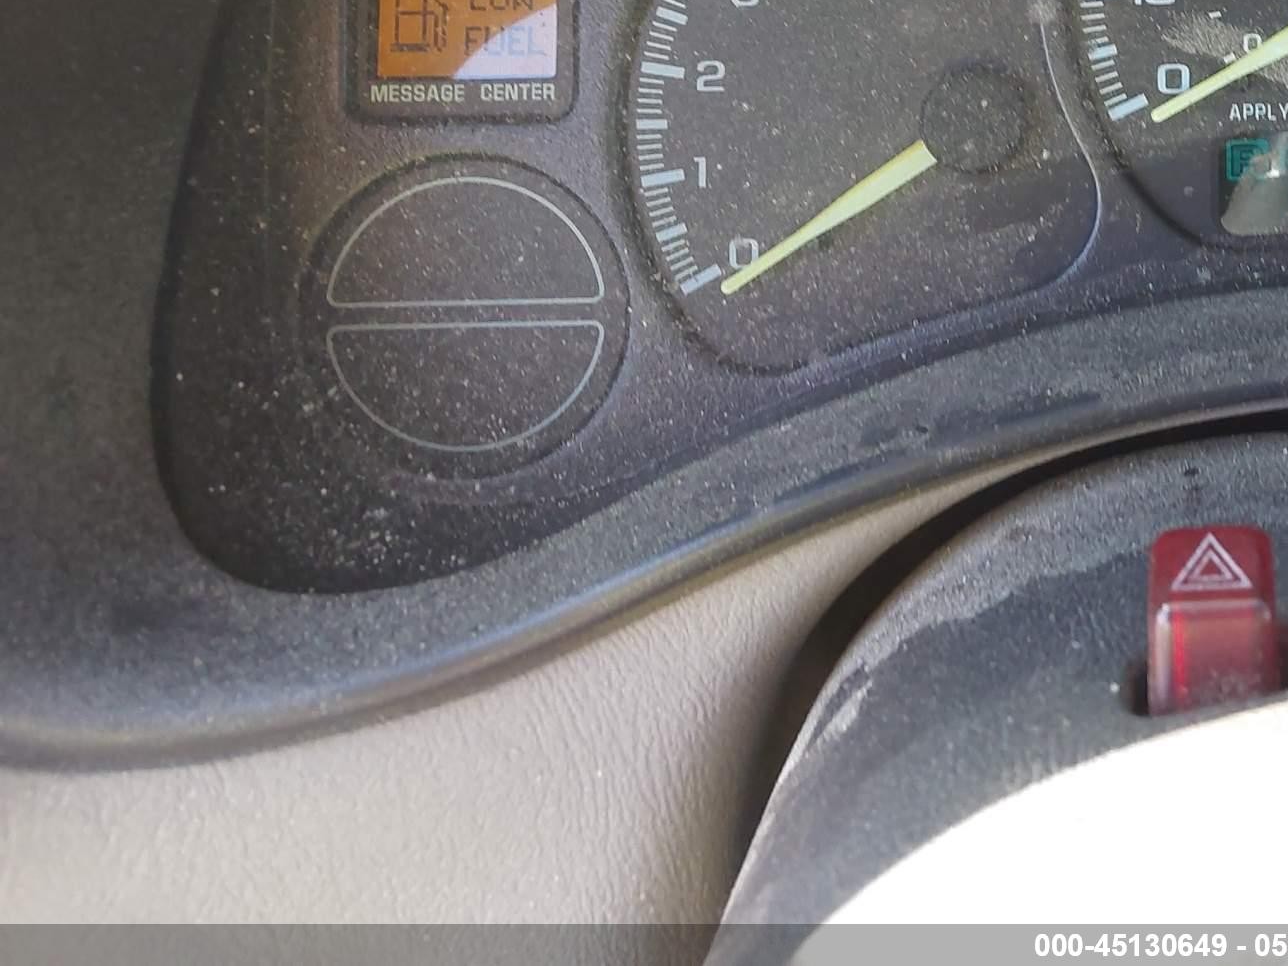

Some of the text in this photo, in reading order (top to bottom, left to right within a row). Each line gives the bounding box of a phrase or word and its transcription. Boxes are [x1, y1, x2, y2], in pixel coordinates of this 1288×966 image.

[464, 26, 548, 56] FUEL
[1243, 33, 1263, 54] 0
[696, 61, 726, 92] 2
[1156, 63, 1190, 93] 0
[370, 84, 556, 102] MESSAGE CENTER
[1229, 103, 1288, 121] APPLY
[694, 157, 708, 187] 1
[729, 238, 759, 269] 0
